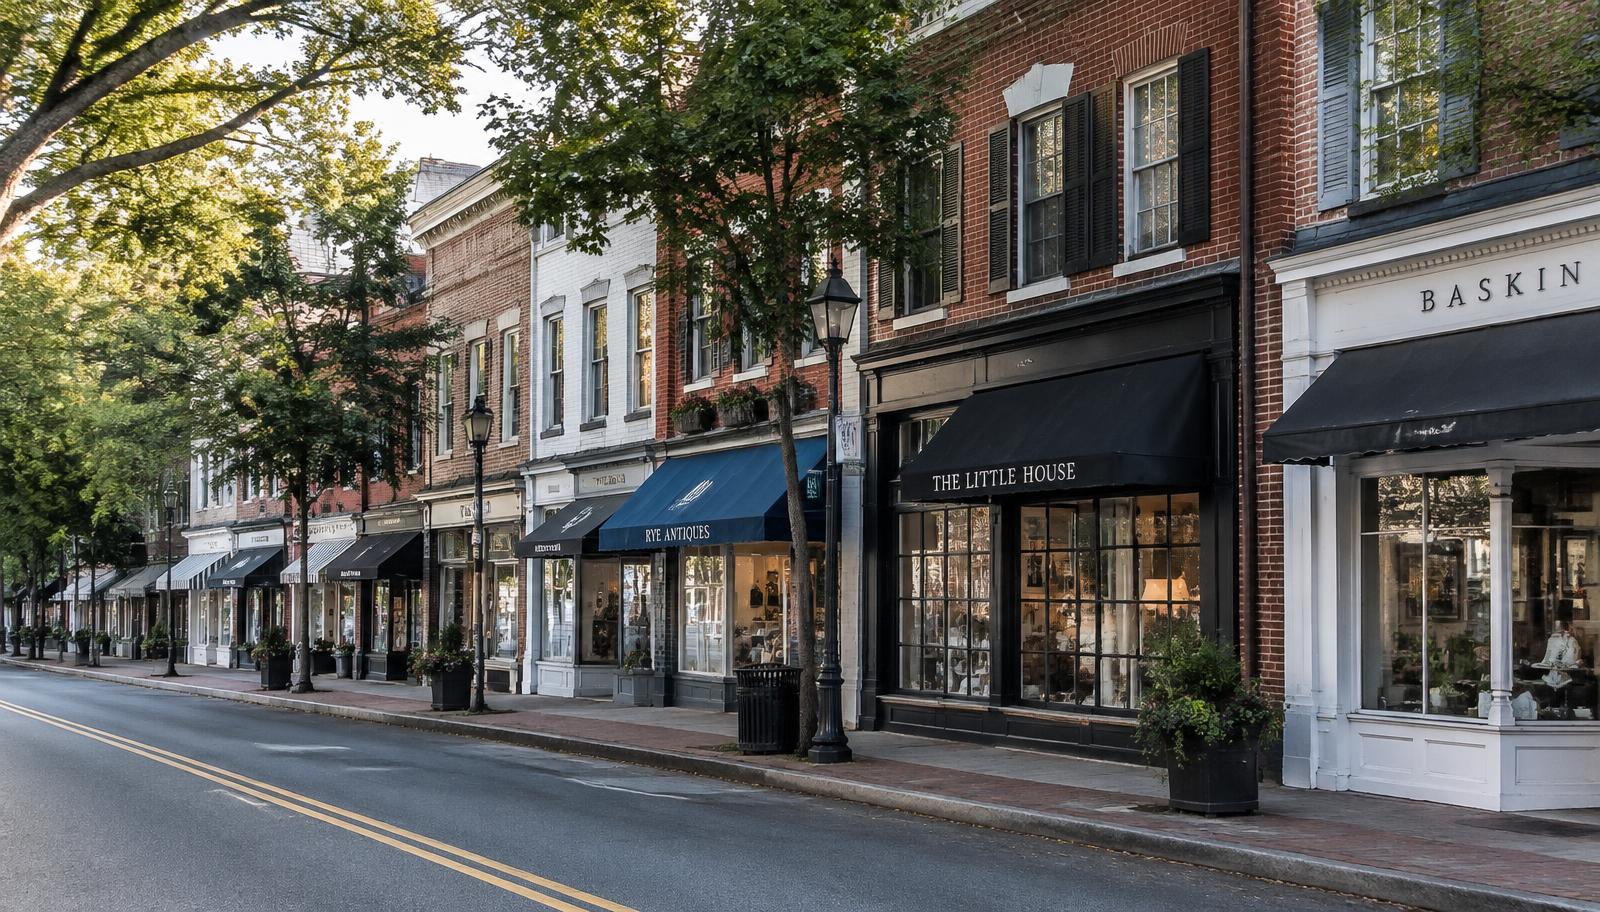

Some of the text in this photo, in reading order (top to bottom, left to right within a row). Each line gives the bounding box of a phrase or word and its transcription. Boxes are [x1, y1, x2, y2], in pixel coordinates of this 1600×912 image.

[1420, 261, 1582, 312] BASKIN
[932, 462, 1076, 492] THE LITTLE HOUSE
[645, 524, 710, 543] RYE ANTIQUES
